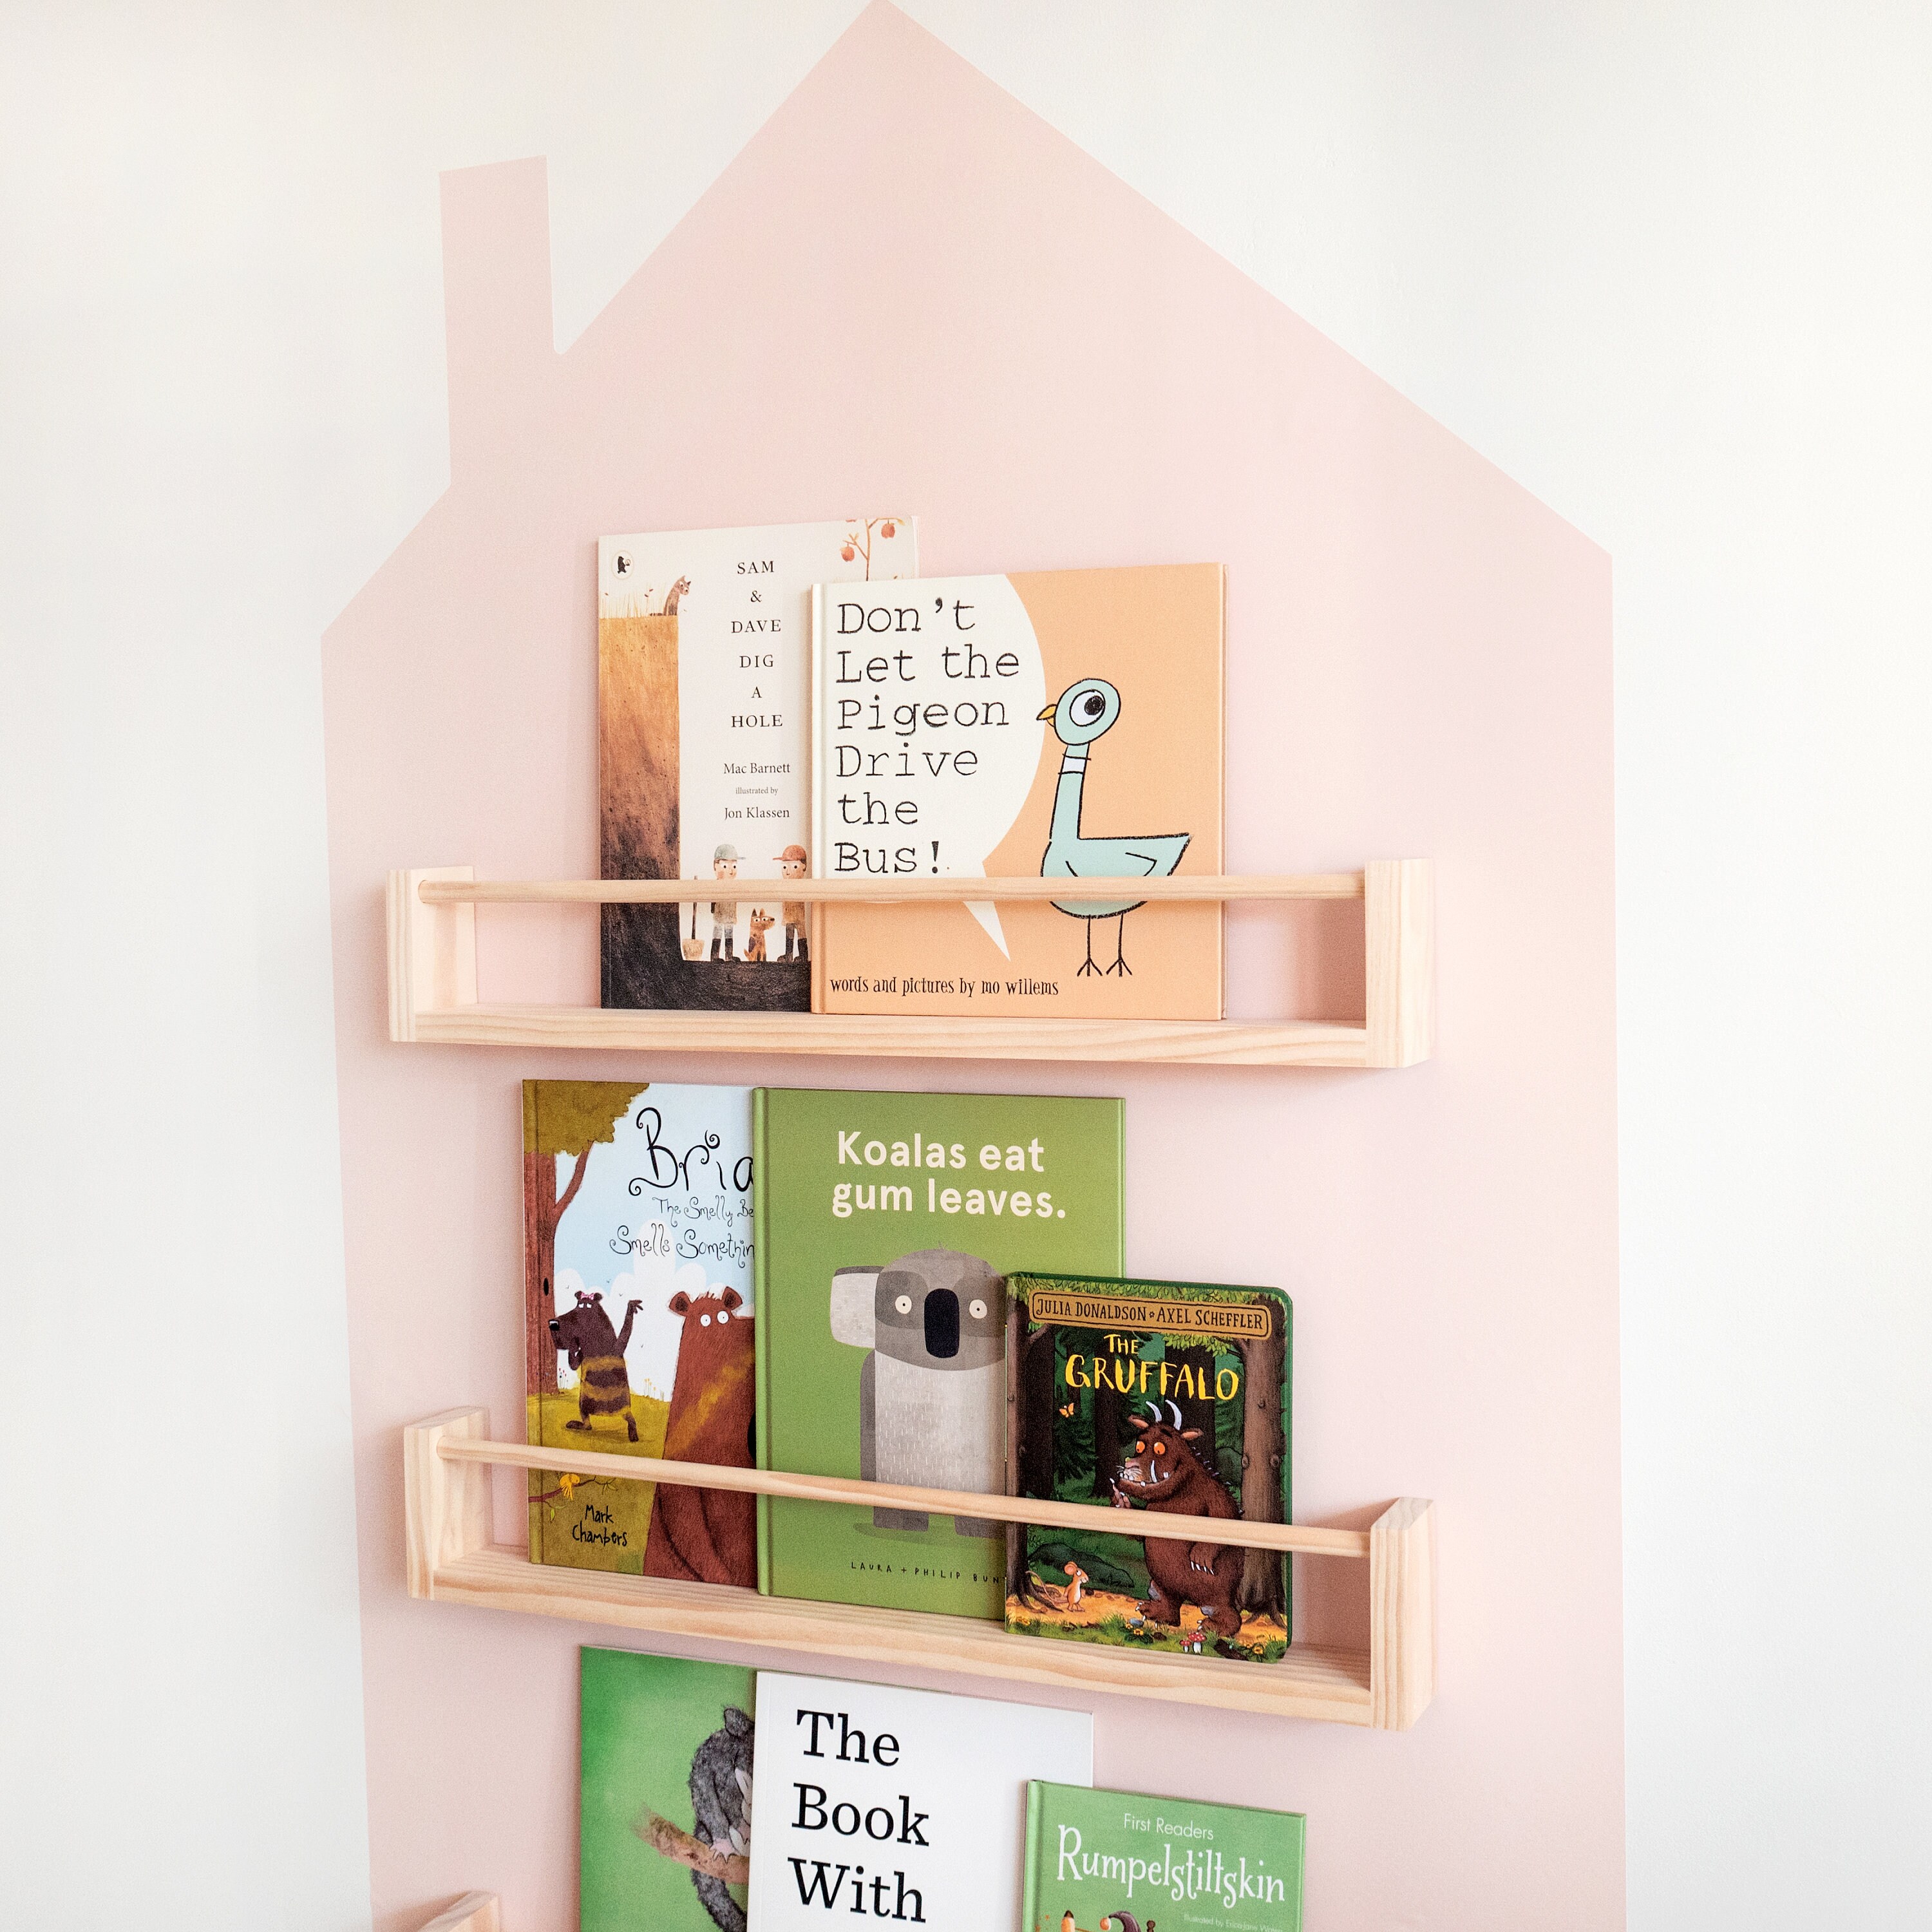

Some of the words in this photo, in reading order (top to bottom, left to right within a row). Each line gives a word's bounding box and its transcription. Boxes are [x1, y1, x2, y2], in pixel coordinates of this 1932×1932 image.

[737, 560, 775, 575] SAM
[750, 591, 762, 603] &
[731, 619, 781, 634] DAVE
[837, 597, 976, 634] Don't
[739, 654, 774, 668] DIG
[837, 650, 916, 683] Let
[942, 644, 1019, 678] the
[751, 687, 762, 699] A
[731, 715, 783, 728] HOLE
[837, 695, 1009, 736] Pigeon
[724, 763, 747, 773] Mac
[750, 762, 791, 773] Barnett
[835, 742, 979, 778] Drive
[770, 787, 778, 795] by
[724, 808, 742, 820] Jon
[746, 807, 790, 818] Klassen
[837, 792, 918, 825] the
[835, 841, 940, 874] Bus!
[830, 976, 869, 992] words
[873, 977, 897, 993] and
[902, 978, 954, 996] pictures
[960, 978, 976, 998] by
[981, 980, 999, 994] mo
[1005, 979, 1059, 996] willems
[629, 1107, 753, 1196] Bria
[838, 1131, 966, 1169] Koalas
[979, 1136, 1045, 1172] eat
[652, 1197, 681, 1227] The
[684, 1195, 734, 1227] Smelly
[832, 1183, 913, 1217] gum
[928, 1177, 1066, 1218] leaves.
[609, 1224, 670, 1256] Smells
[676, 1229, 755, 1268] Somethin
[1036, 1298, 1073, 1316] JULIA
[1075, 1301, 1147, 1321] DONALDSON
[1157, 1307, 1191, 1323] AXEL
[1195, 1310, 1263, 1329] SCHEFFLER
[1104, 1334, 1139, 1354] THE
[1065, 1354, 1239, 1400] GRUFFALO
[585, 1504, 614, 1524] Mark
[572, 1520, 628, 1547] Chambers
[851, 1562, 892, 1573] LAURA
[915, 1567, 960, 1579] PHILIP
[973, 1573, 1007, 1584] BUN
[797, 1710, 900, 1766] The
[791, 1782, 929, 1846] Book
[1124, 1813, 1151, 1831] First
[1156, 1818, 1214, 1840] Readers
[1057, 1824, 1285, 1909] Rumpelstiltskin
[788, 1857, 925, 1923] With
